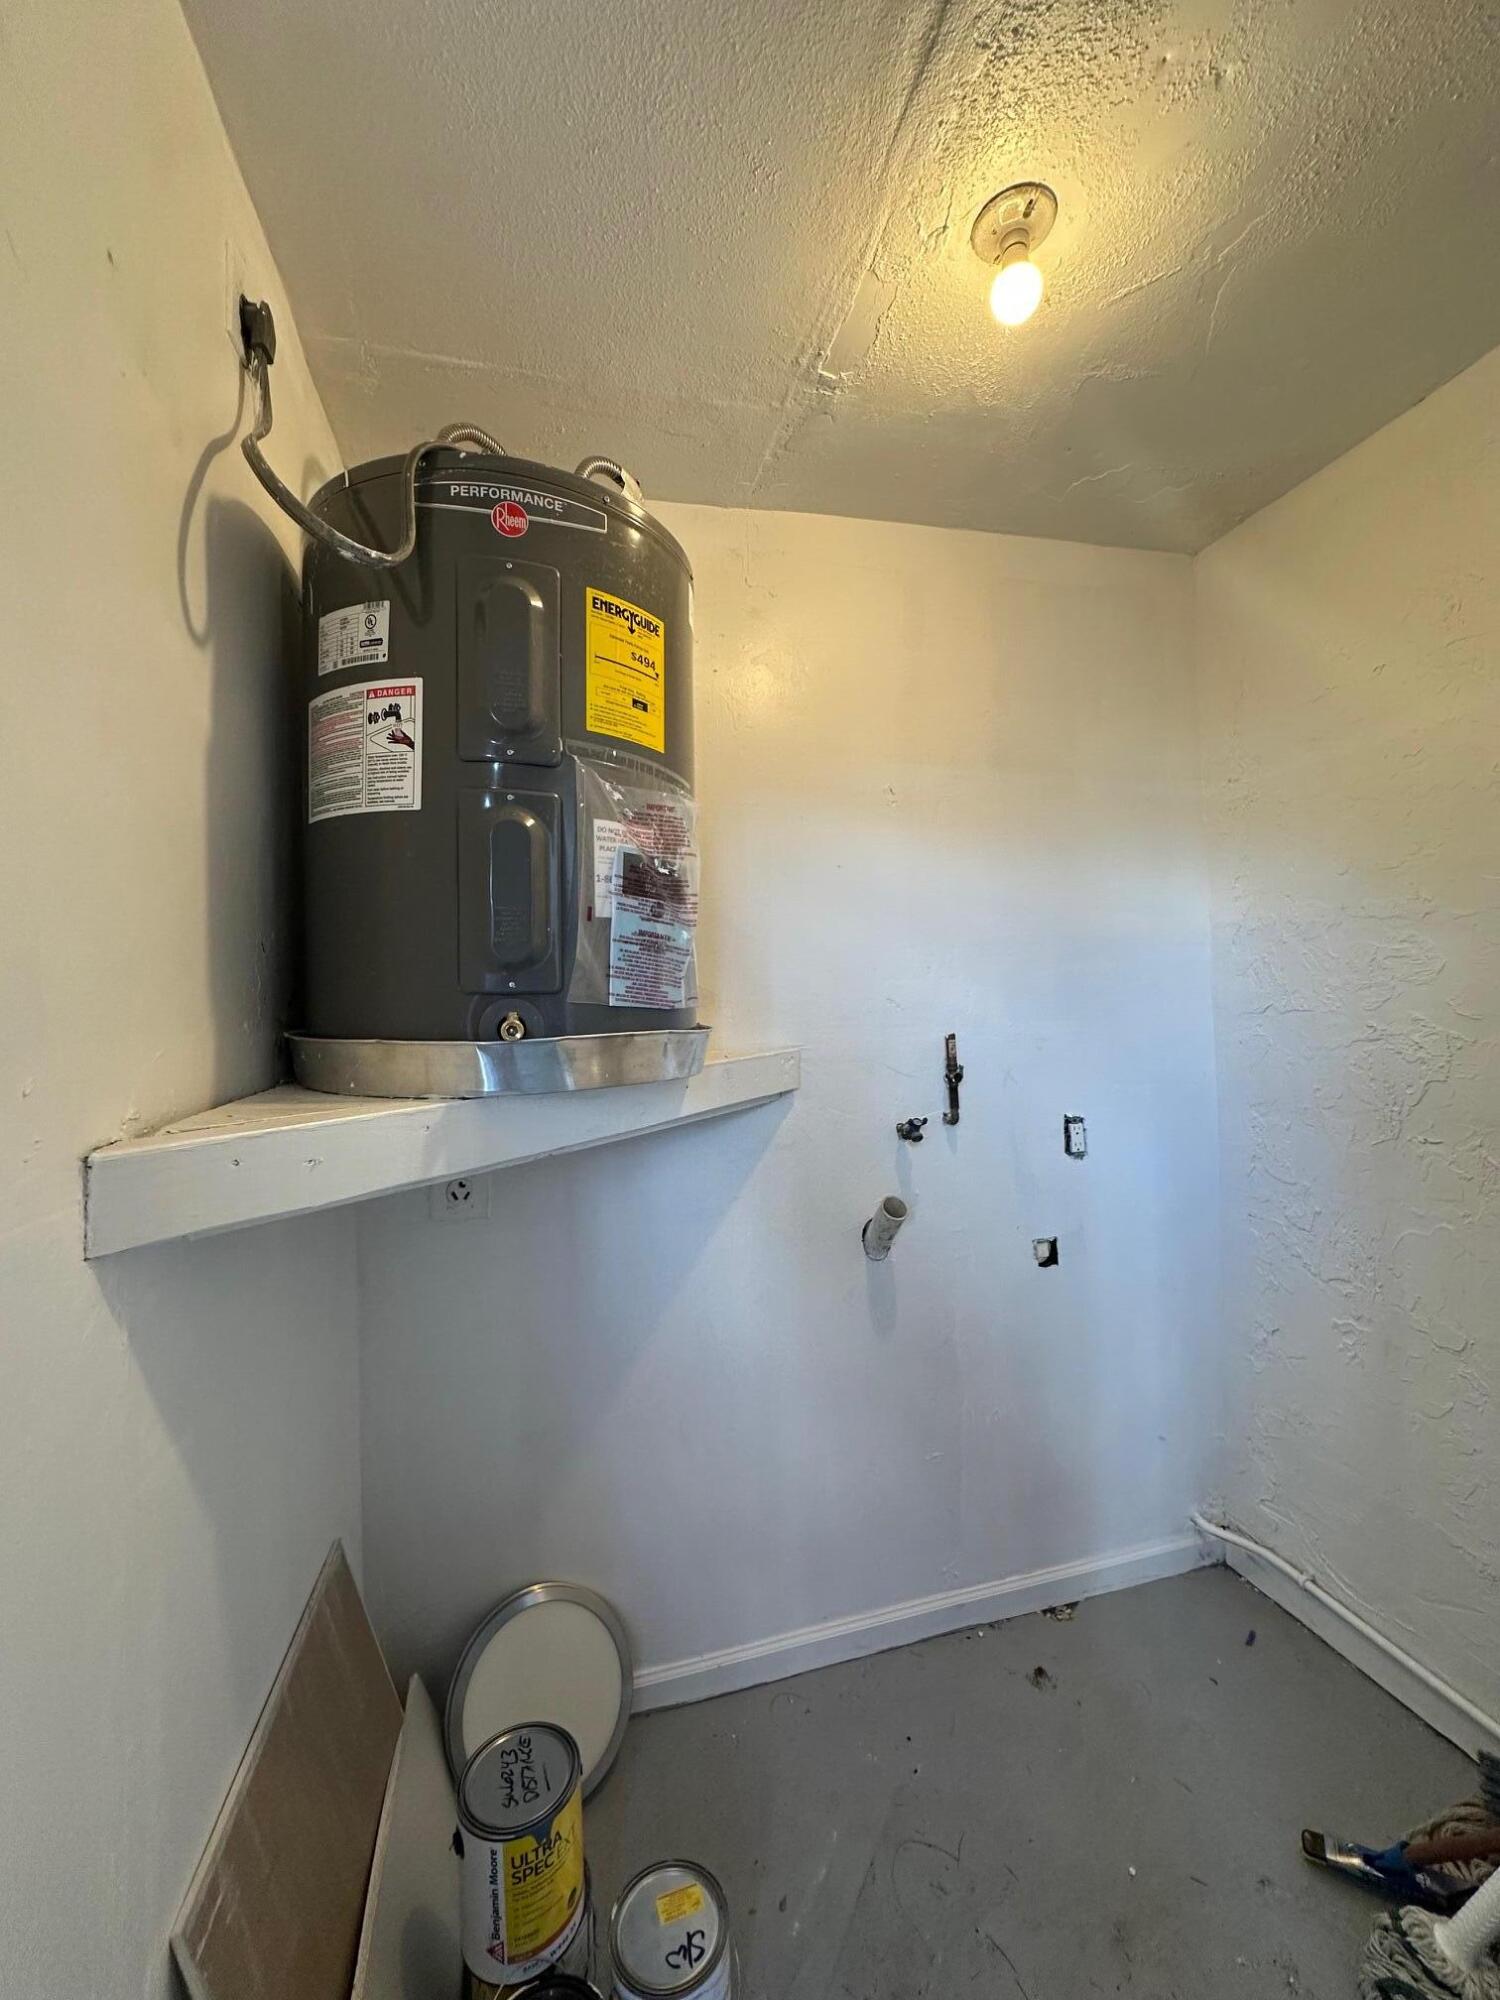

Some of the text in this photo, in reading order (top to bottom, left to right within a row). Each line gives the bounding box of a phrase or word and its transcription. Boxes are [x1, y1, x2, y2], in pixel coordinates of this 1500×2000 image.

[450, 485, 564, 512] PERFORMANCE
[496, 503, 527, 531] Rheem
[377, 687, 413, 697] DANGER
[511, 1830, 562, 1870] ULTRA
[512, 1851, 555, 1886] SPEC
[489, 1849, 502, 1940] Benjamin Moore
